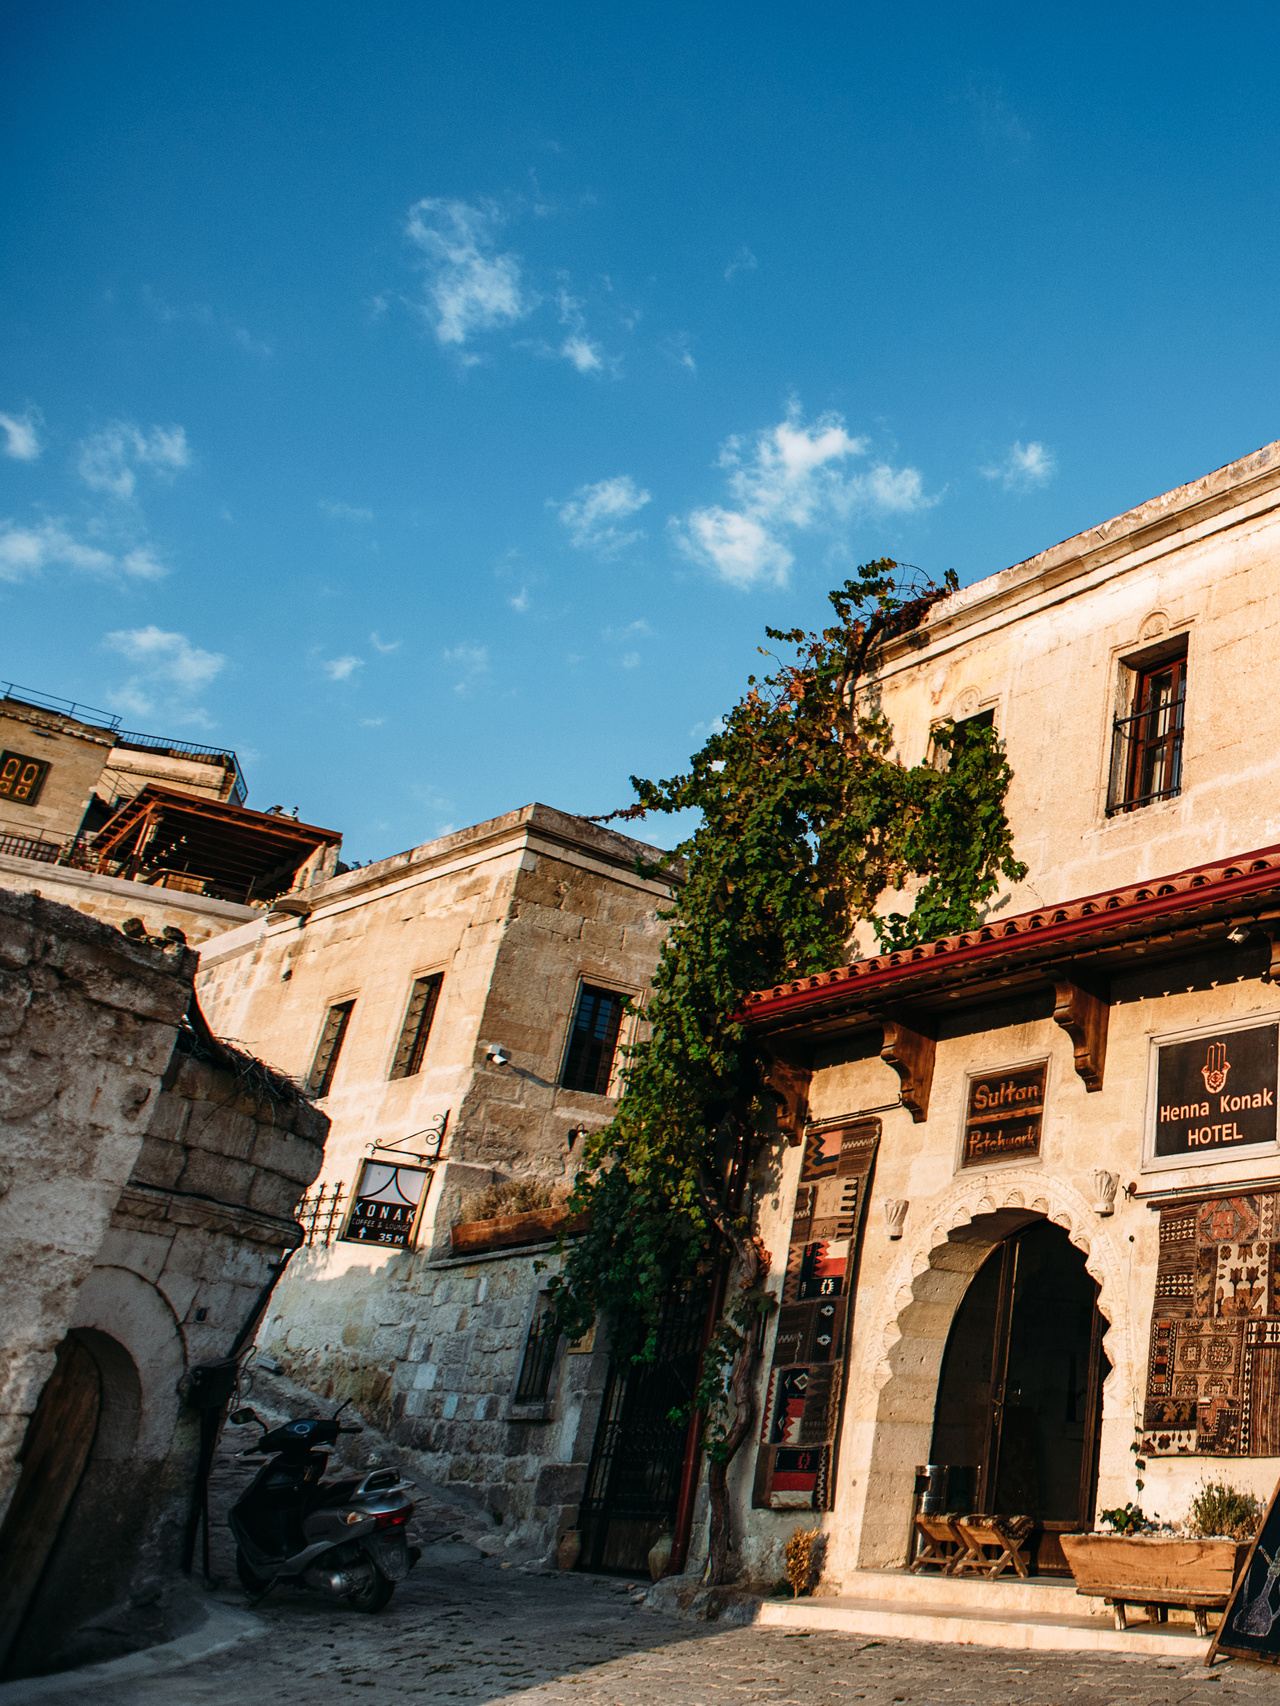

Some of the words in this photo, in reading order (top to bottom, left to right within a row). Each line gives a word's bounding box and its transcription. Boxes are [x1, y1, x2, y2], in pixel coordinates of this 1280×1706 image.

[973, 1080, 1039, 1110] Sultan
[1160, 1101, 1210, 1123] Henna
[1220, 1087, 1274, 1113] Konak
[968, 1125, 1036, 1158] Patchwork
[1187, 1122, 1244, 1146] HOTEL
[353, 1201, 417, 1223] KONAK
[351, 1217, 376, 1228] COFFEE
[377, 1221, 383, 1229] &
[384, 1221, 411, 1232] LOUNGE
[378, 1232, 393, 1243] 35
[393, 1234, 405, 1244] M
